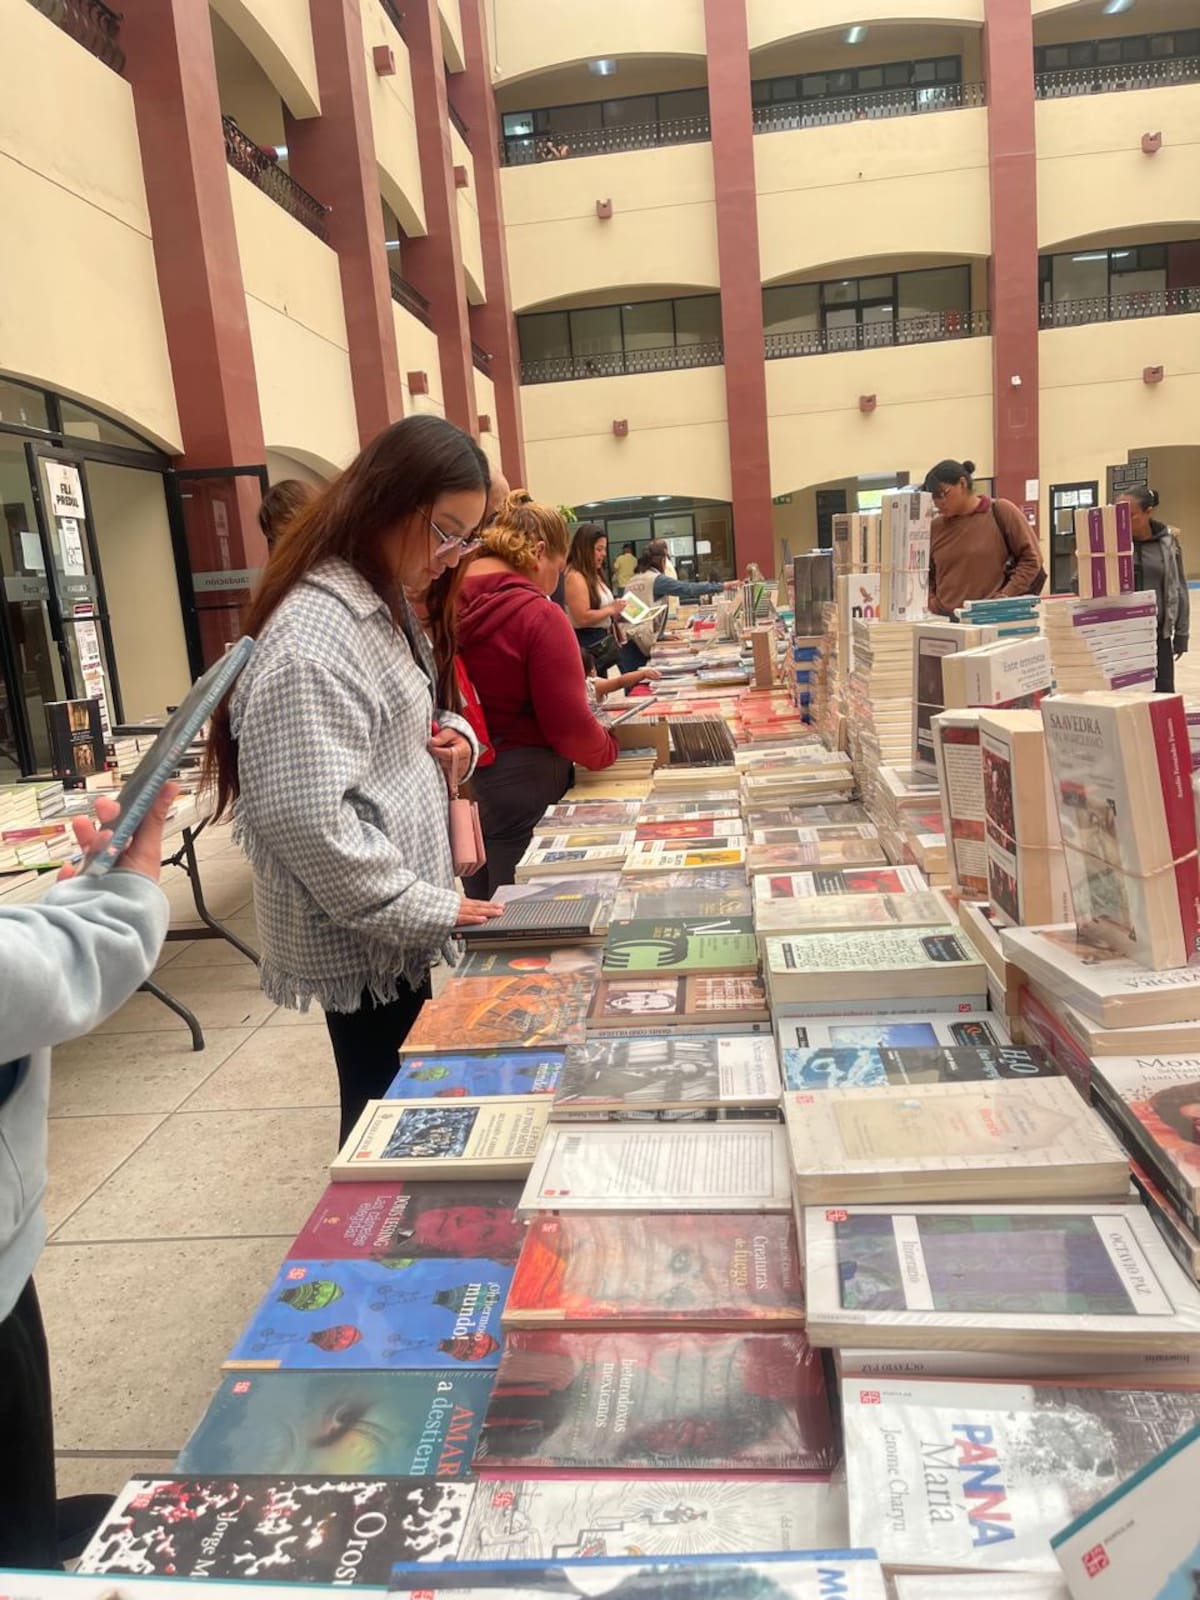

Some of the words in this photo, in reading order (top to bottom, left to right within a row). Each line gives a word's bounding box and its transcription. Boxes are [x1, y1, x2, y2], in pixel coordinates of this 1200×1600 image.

[1050, 713, 1103, 735] SAAVEDRA
[388, 1195, 412, 1217] DORIS
[373, 1217, 400, 1247] LESSING
[728, 1250, 753, 1287] fuego
[752, 1235, 769, 1290] Creaturas
[902, 1240, 924, 1284] Itinerario
[1110, 1232, 1139, 1274] OCTAVIO
[1131, 1274, 1152, 1296] PAZ
[450, 1282, 482, 1341] mundo!
[474, 1301, 498, 1342] hermoso
[437, 1380, 454, 1392] a
[860, 1363, 878, 1373] PAZ
[595, 1362, 616, 1428] mexicanos
[614, 1359, 638, 1433] heterodoxos
[437, 1404, 476, 1476] AMAR
[880, 1427, 902, 1477] Jerome
[886, 1478, 910, 1532] Charyn
[919, 1440, 967, 1525] María
[952, 1423, 1016, 1548] PANNA
[200, 1514, 239, 1555] Jorge
